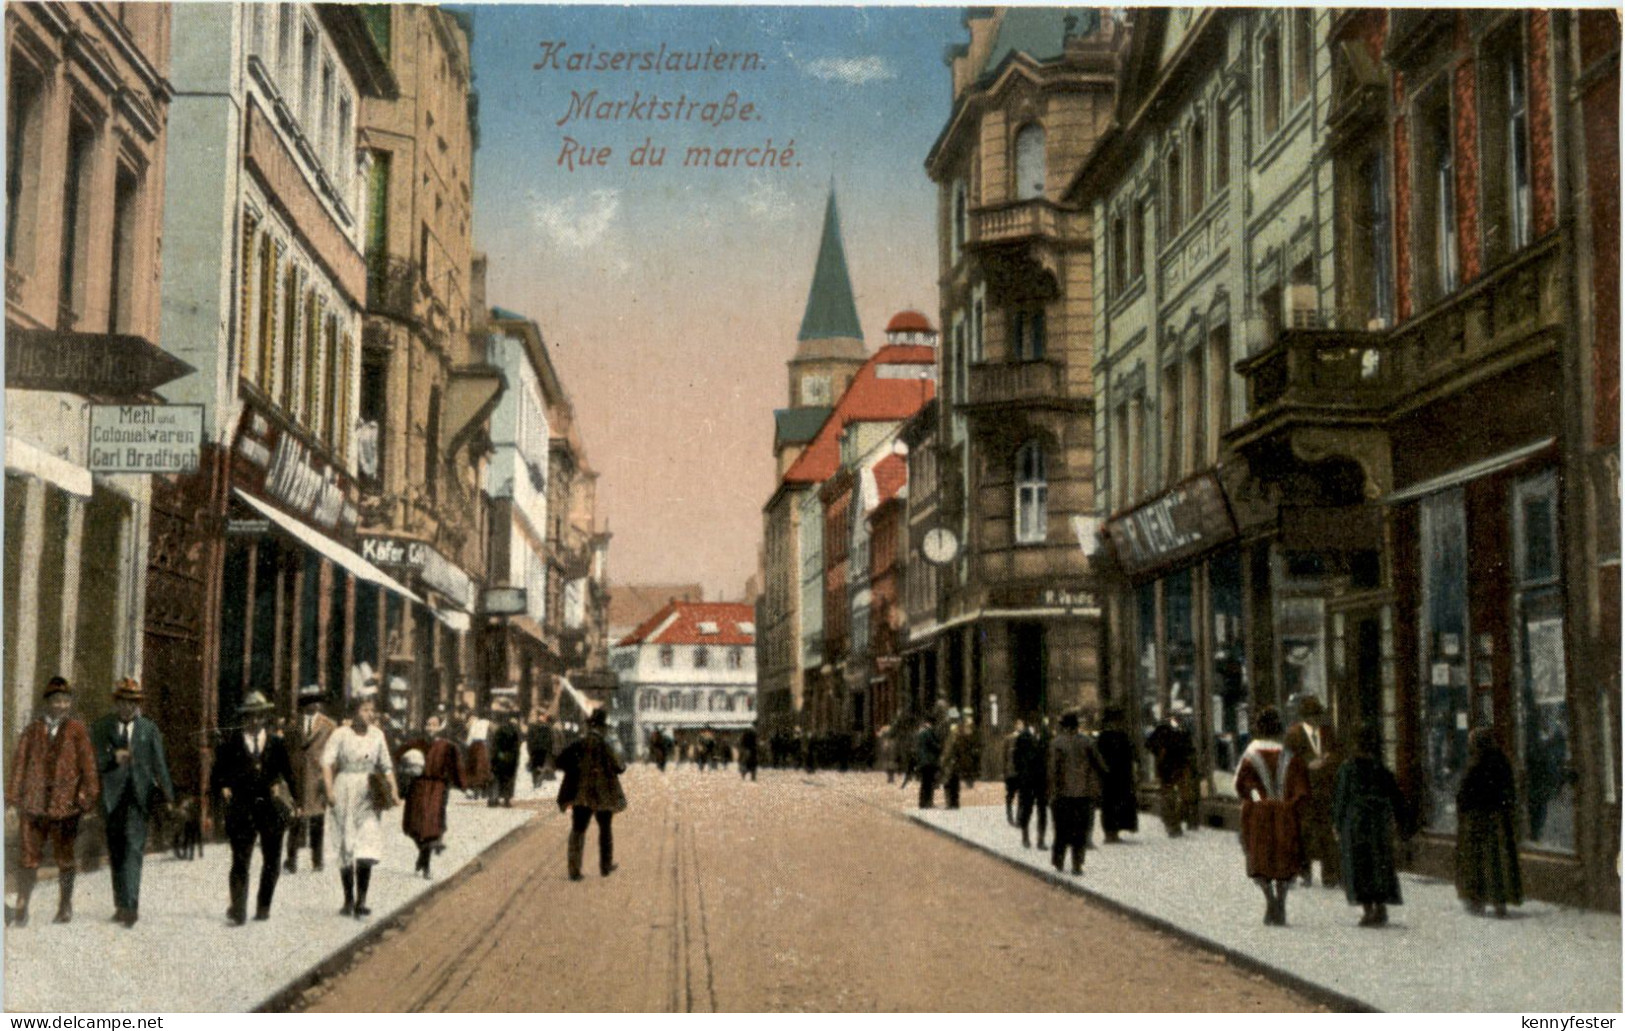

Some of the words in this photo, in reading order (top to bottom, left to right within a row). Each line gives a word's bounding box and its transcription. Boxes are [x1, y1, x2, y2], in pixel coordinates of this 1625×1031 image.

[119, 406, 154, 424] Mehl
[158, 414, 175, 424] und
[93, 426, 194, 443] Colonialwaren
[92, 448, 120, 467] Carl
